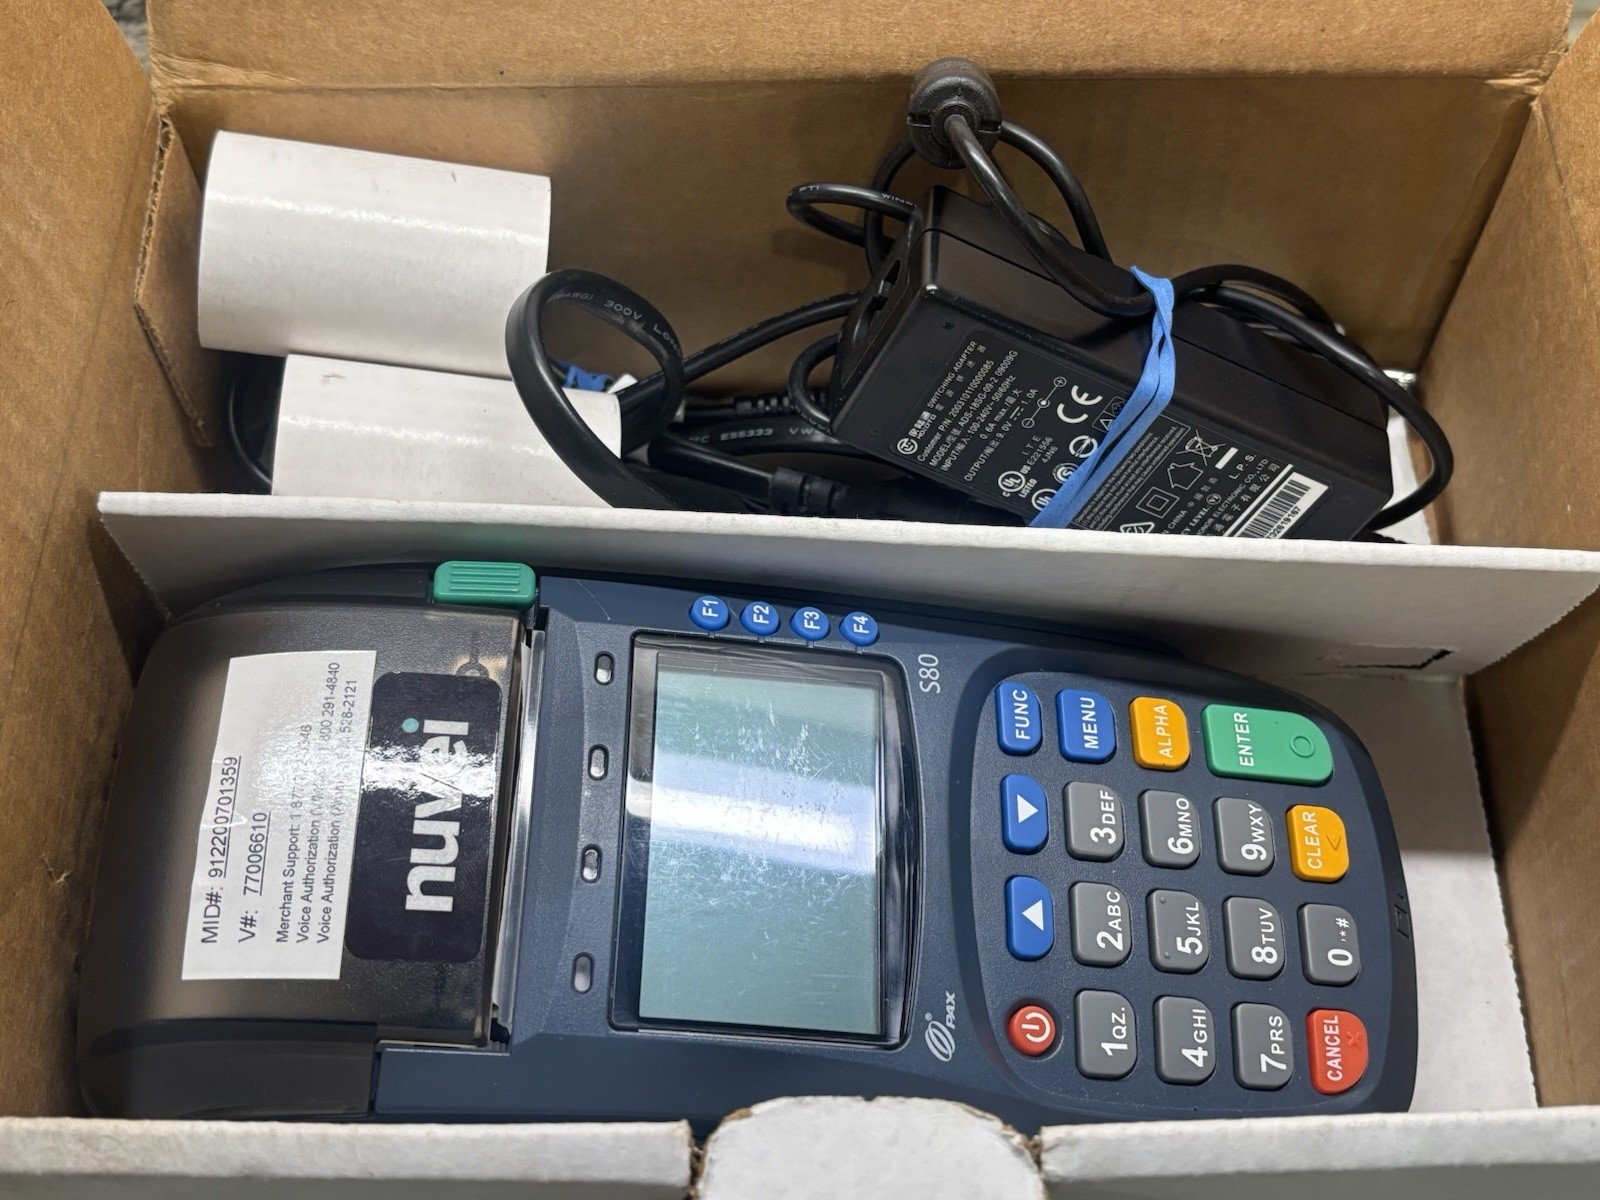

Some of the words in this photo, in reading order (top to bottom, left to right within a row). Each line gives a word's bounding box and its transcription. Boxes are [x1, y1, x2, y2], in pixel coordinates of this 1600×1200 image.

[604, 299, 643, 320] 300V
[927, 372, 954, 407] SWITCHING
[953, 341, 976, 371] ADAPTER
[958, 377, 998, 427] ADS-18SG-09-2
[917, 432, 941, 461] Customer
[1026, 437, 1052, 465] E221556
[1018, 478, 1036, 497] LISTED
[1208, 459, 1280, 537] 通電子有限公司
[1212, 483, 1245, 517] ELECTRONIC
[1167, 510, 1187, 528] CHINA
[702, 599, 719, 618] F1
[753, 604, 770, 625] F2
[804, 610, 820, 630] F3
[854, 615, 870, 634] F4
[321, 663, 340, 717] 291-4840
[917, 653, 941, 694] S80
[337, 679, 358, 734] 528-2121
[1012, 689, 1031, 740] FUNC
[1082, 696, 1099, 750] MENU
[1153, 704, 1175, 759] ALPHA
[1233, 711, 1255, 767] ENTER
[208, 756, 238, 879] 912200701359
[1301, 810, 1323, 870] CLEAR
[243, 812, 268, 896] 77006610
[298, 820, 321, 903] Authorization
[319, 821, 341, 903] Authorization
[201, 886, 224, 943] MID#:
[238, 910, 258, 942] V#:
[276, 881, 295, 943] Merchant
[296, 906, 312, 943] Voice
[316, 906, 332, 943] Voice
[945, 990, 957, 1030] PAX
[1327, 1015, 1344, 1082] CANCEL
